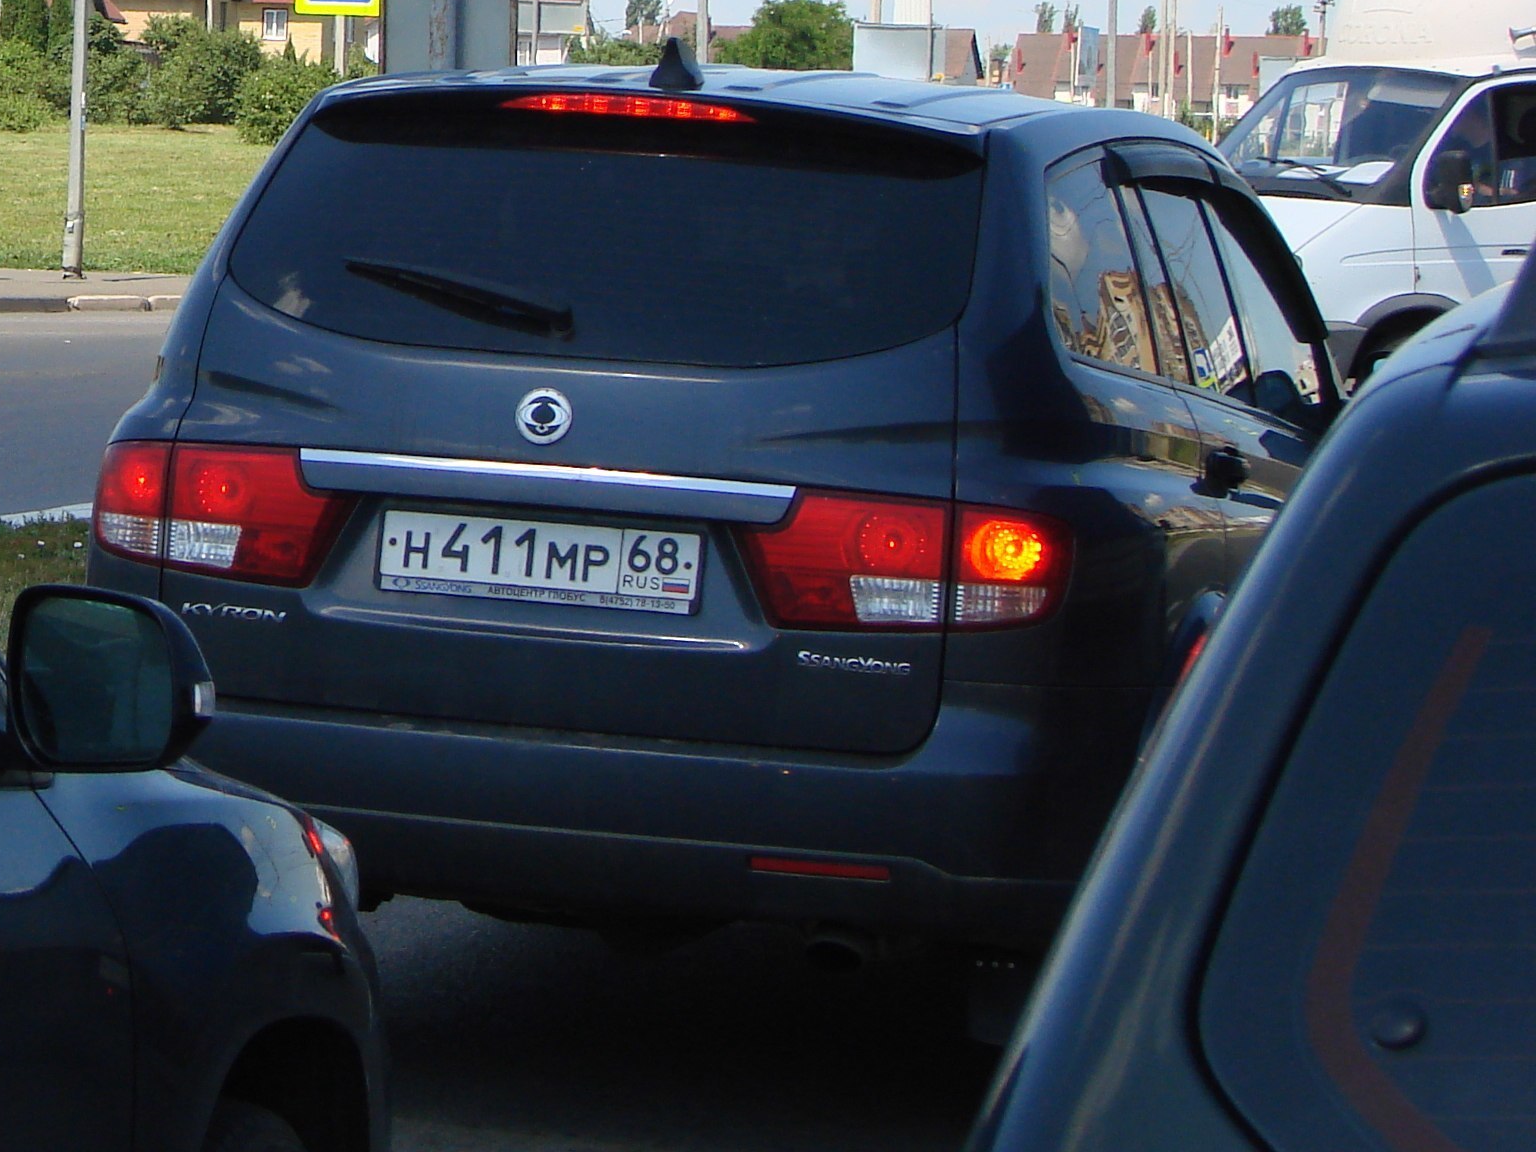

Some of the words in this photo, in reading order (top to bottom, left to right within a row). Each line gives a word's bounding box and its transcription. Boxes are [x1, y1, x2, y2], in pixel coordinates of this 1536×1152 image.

[402, 523, 611, 583] Н411МР
[626, 534, 680, 576] 68
[622, 574, 661, 591] RUS
[486, 586, 546, 600] АВТОЦЕНТР
[547, 590, 586, 603] ГЛОБУС
[180, 601, 287, 624] KYRON
